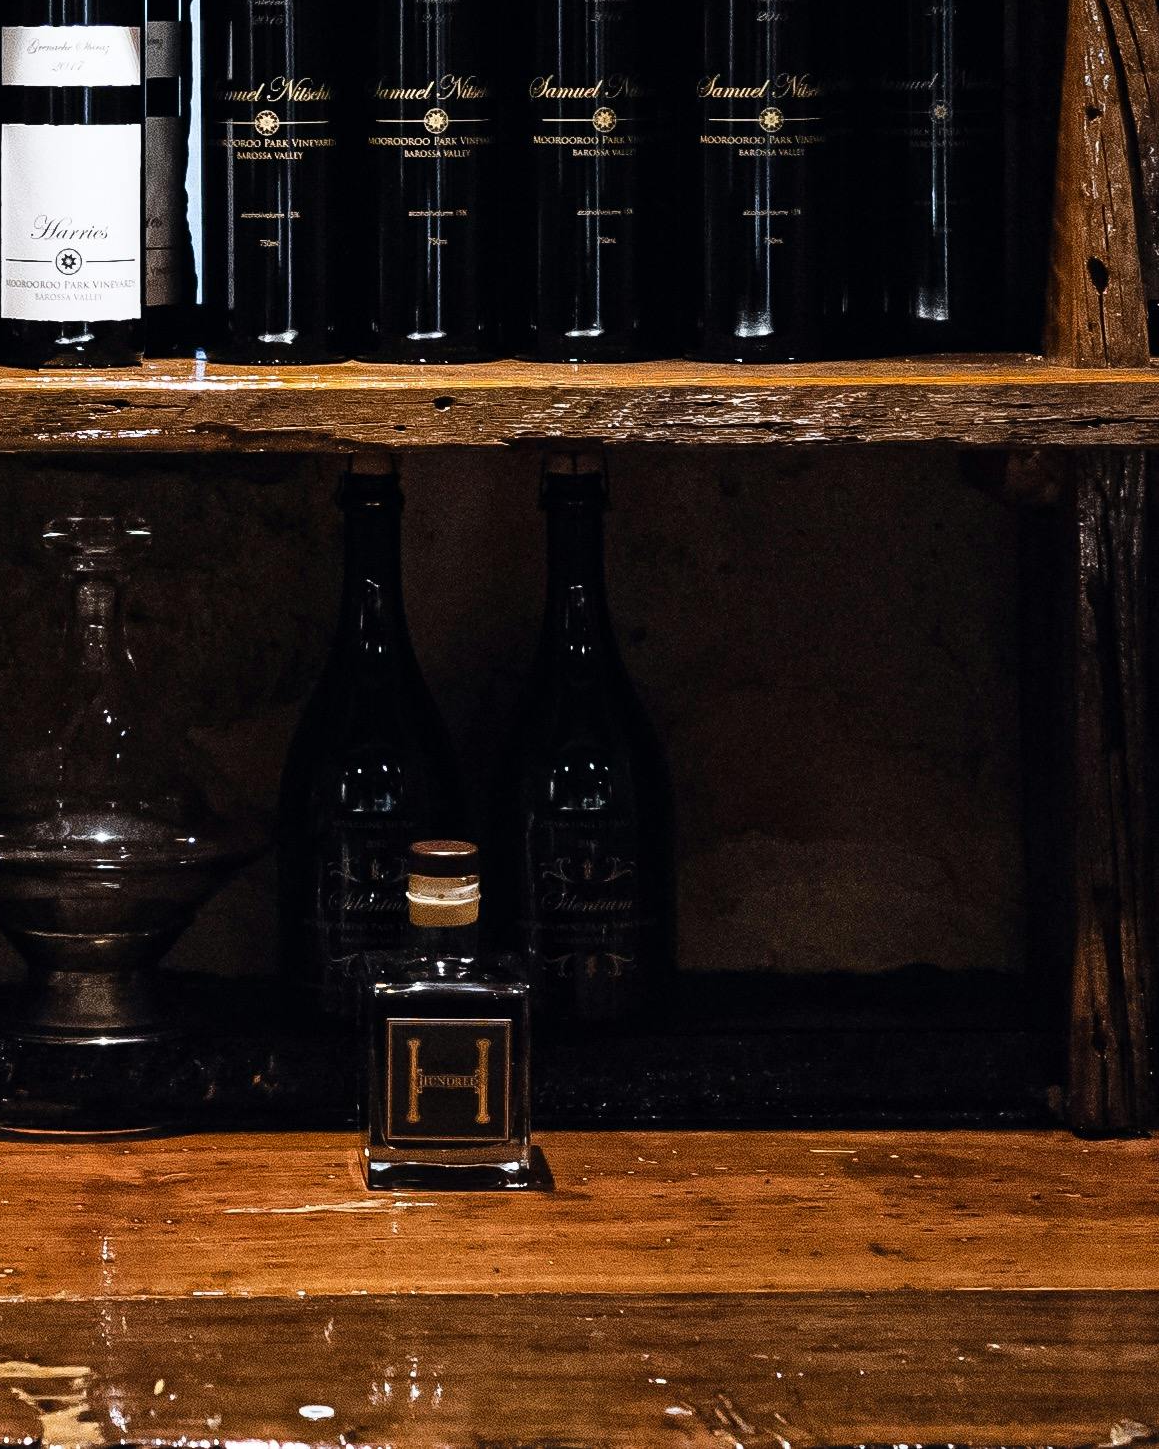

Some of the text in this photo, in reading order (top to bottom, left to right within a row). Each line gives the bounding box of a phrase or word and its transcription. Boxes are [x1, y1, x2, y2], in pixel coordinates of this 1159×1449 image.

[216, 81, 266, 102] amuel
[529, 73, 603, 100] Samuel
[696, 73, 771, 100] Samuel
[264, 138, 289, 148] PARK
[433, 135, 457, 146] PARK
[533, 135, 599, 145] MOOROOROO
[699, 135, 766, 145] MOOROOROO
[769, 135, 793, 145] PARK
[236, 150, 304, 160] BAROSSA VALLEY
[403, 149, 471, 159] BAROSSA VALLEY
[571, 148, 610, 157] BAROSSA
[738, 148, 777, 157] BAROSSA
[30, 213, 110, 241] Harries
[64, 279, 90, 291] PARK
[34, 292, 77, 302] BAROSSA
